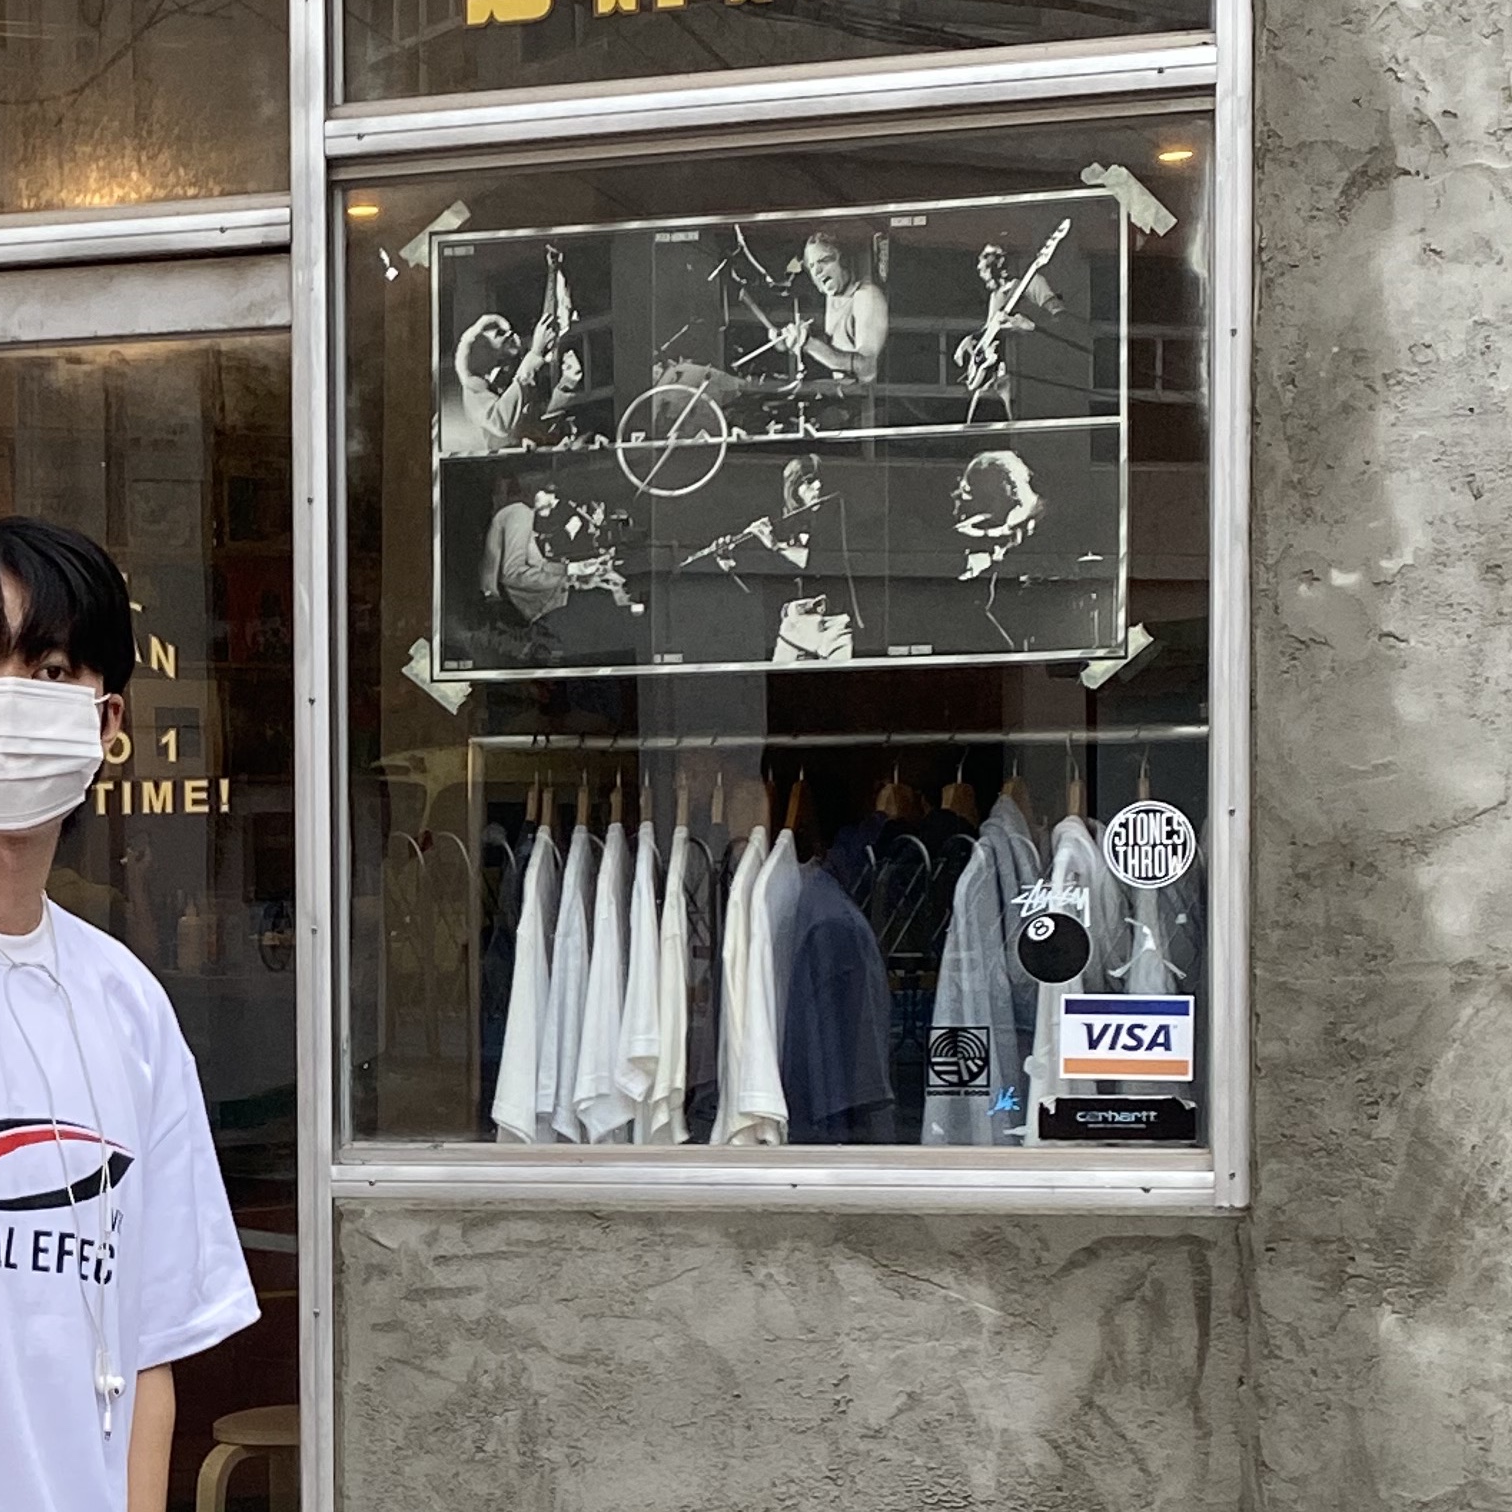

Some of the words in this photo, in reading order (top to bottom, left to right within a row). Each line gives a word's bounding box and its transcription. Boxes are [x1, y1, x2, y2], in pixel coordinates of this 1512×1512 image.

[158, 727, 178, 763] 1
[91, 778, 230, 816] TIME!
[1114, 811, 1185, 846] STONES
[1114, 845, 1185, 879] THROW
[1082, 1022, 1172, 1052] VISA
